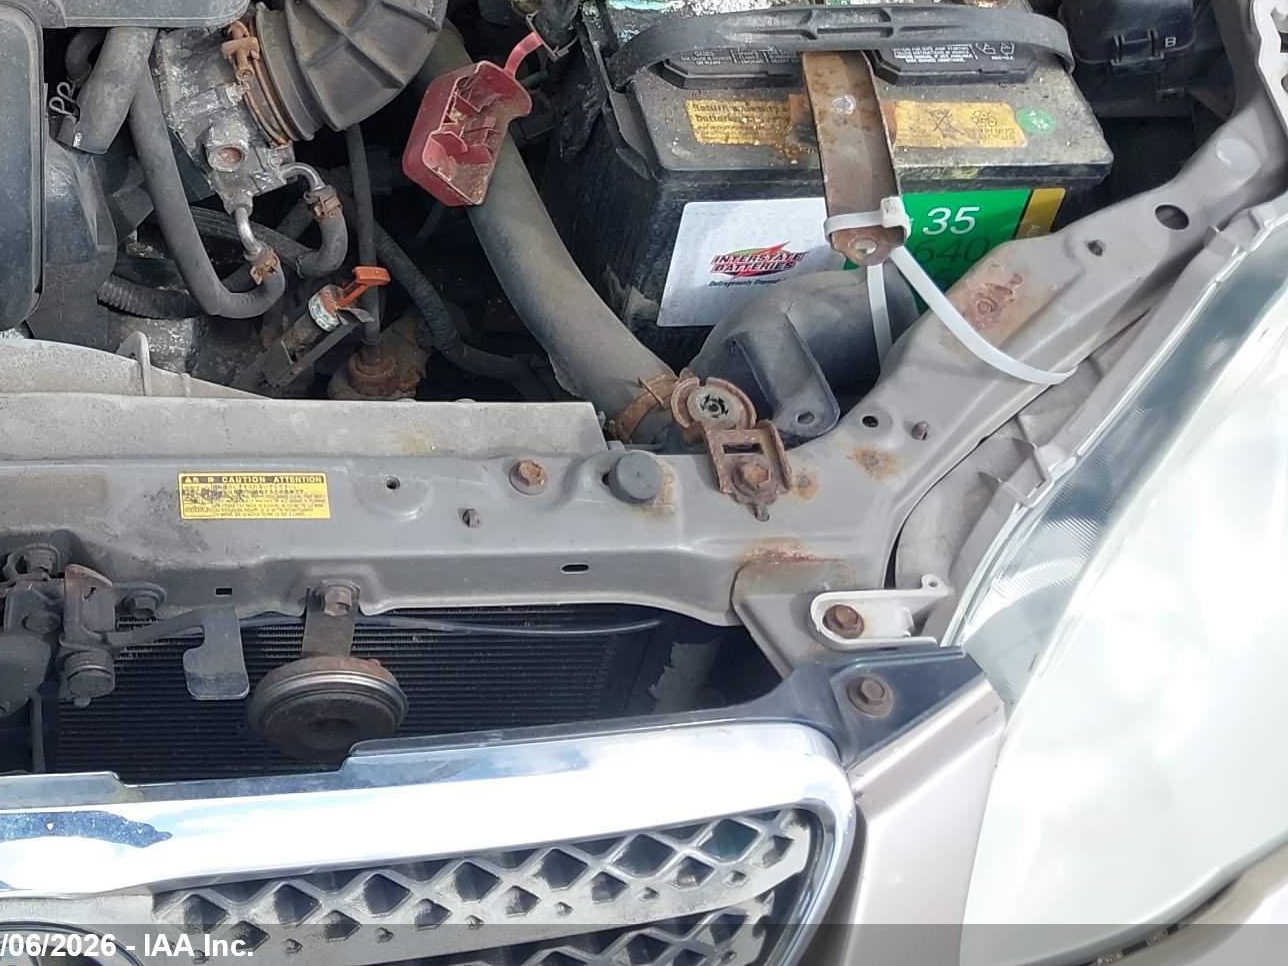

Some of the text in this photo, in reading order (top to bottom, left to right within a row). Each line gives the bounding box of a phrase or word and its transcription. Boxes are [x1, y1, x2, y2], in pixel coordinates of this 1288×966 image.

[922, 206, 980, 235] 35
[711, 252, 803, 266] INTERSTATE
[711, 261, 797, 273] BATTERIES
